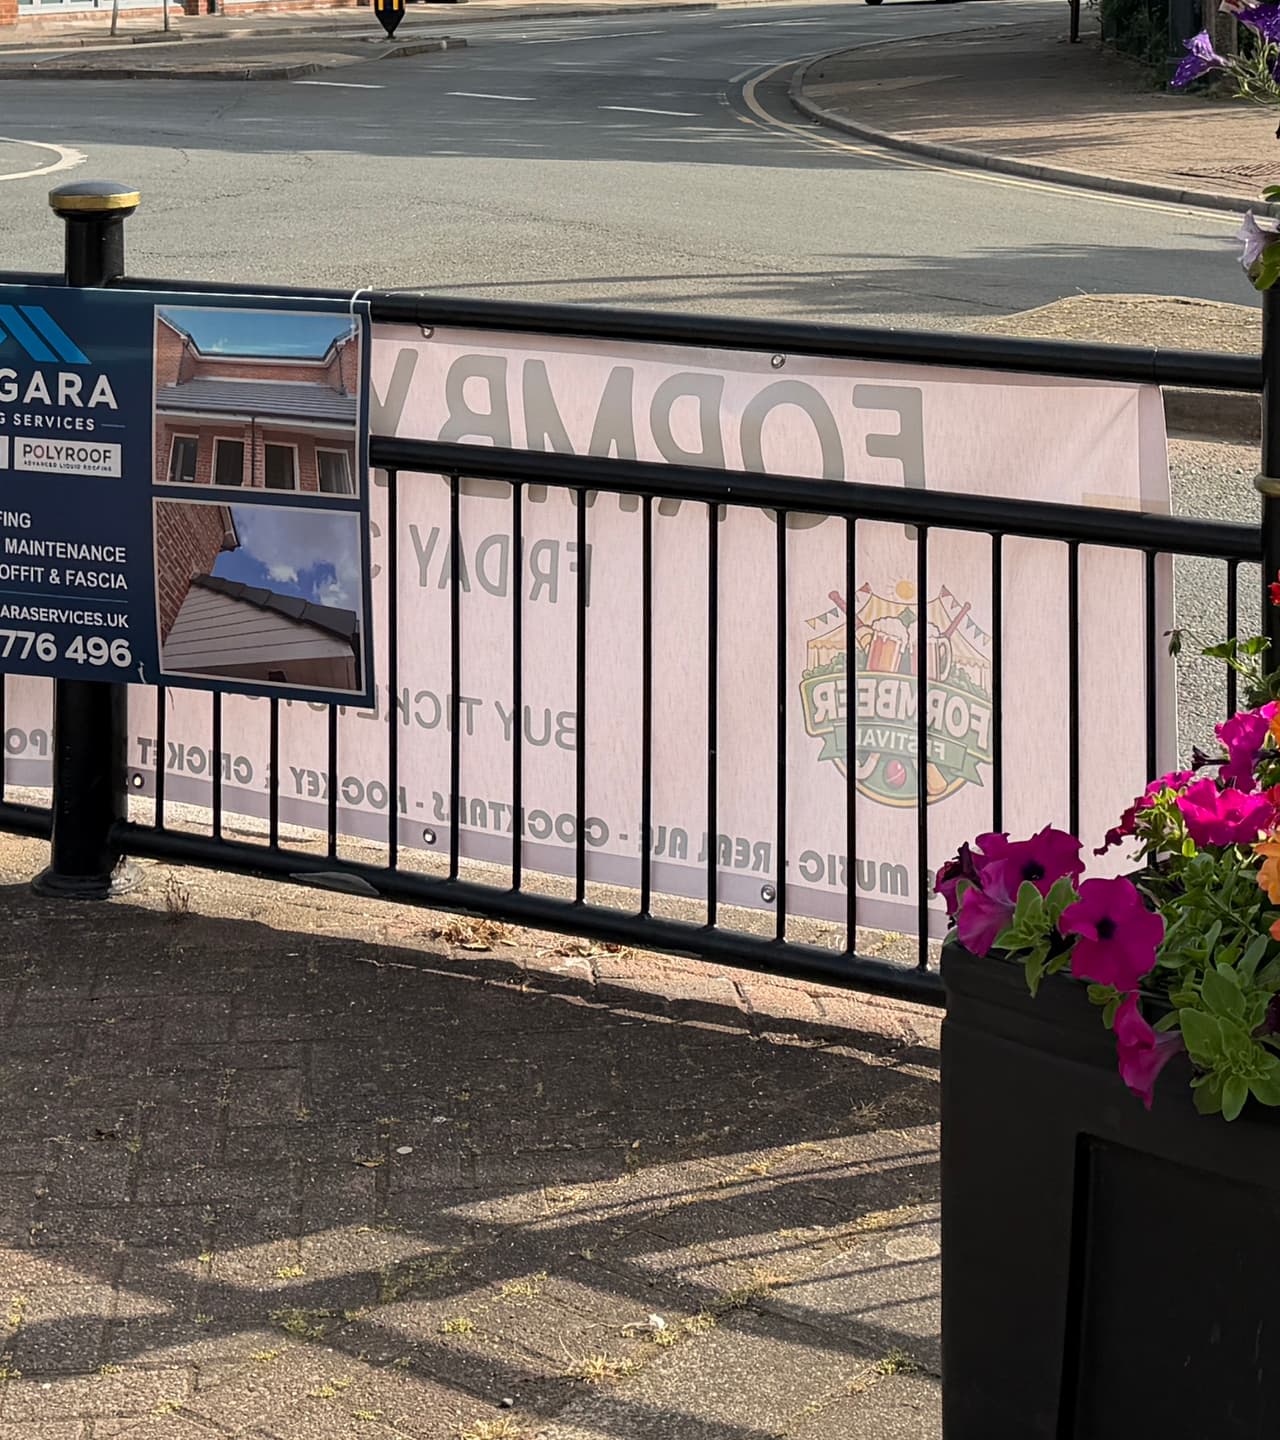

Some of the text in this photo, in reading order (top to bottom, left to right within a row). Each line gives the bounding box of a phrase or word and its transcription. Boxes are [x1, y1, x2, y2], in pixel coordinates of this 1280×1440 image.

[12, 412, 96, 432] SERVICES
[23, 443, 112, 464] POLYROOF
[5, 536, 126, 564] MAINTENANCE
[48, 567, 61, 584] &
[65, 569, 128, 590] FASCIA
[65, 635, 132, 669] 496
